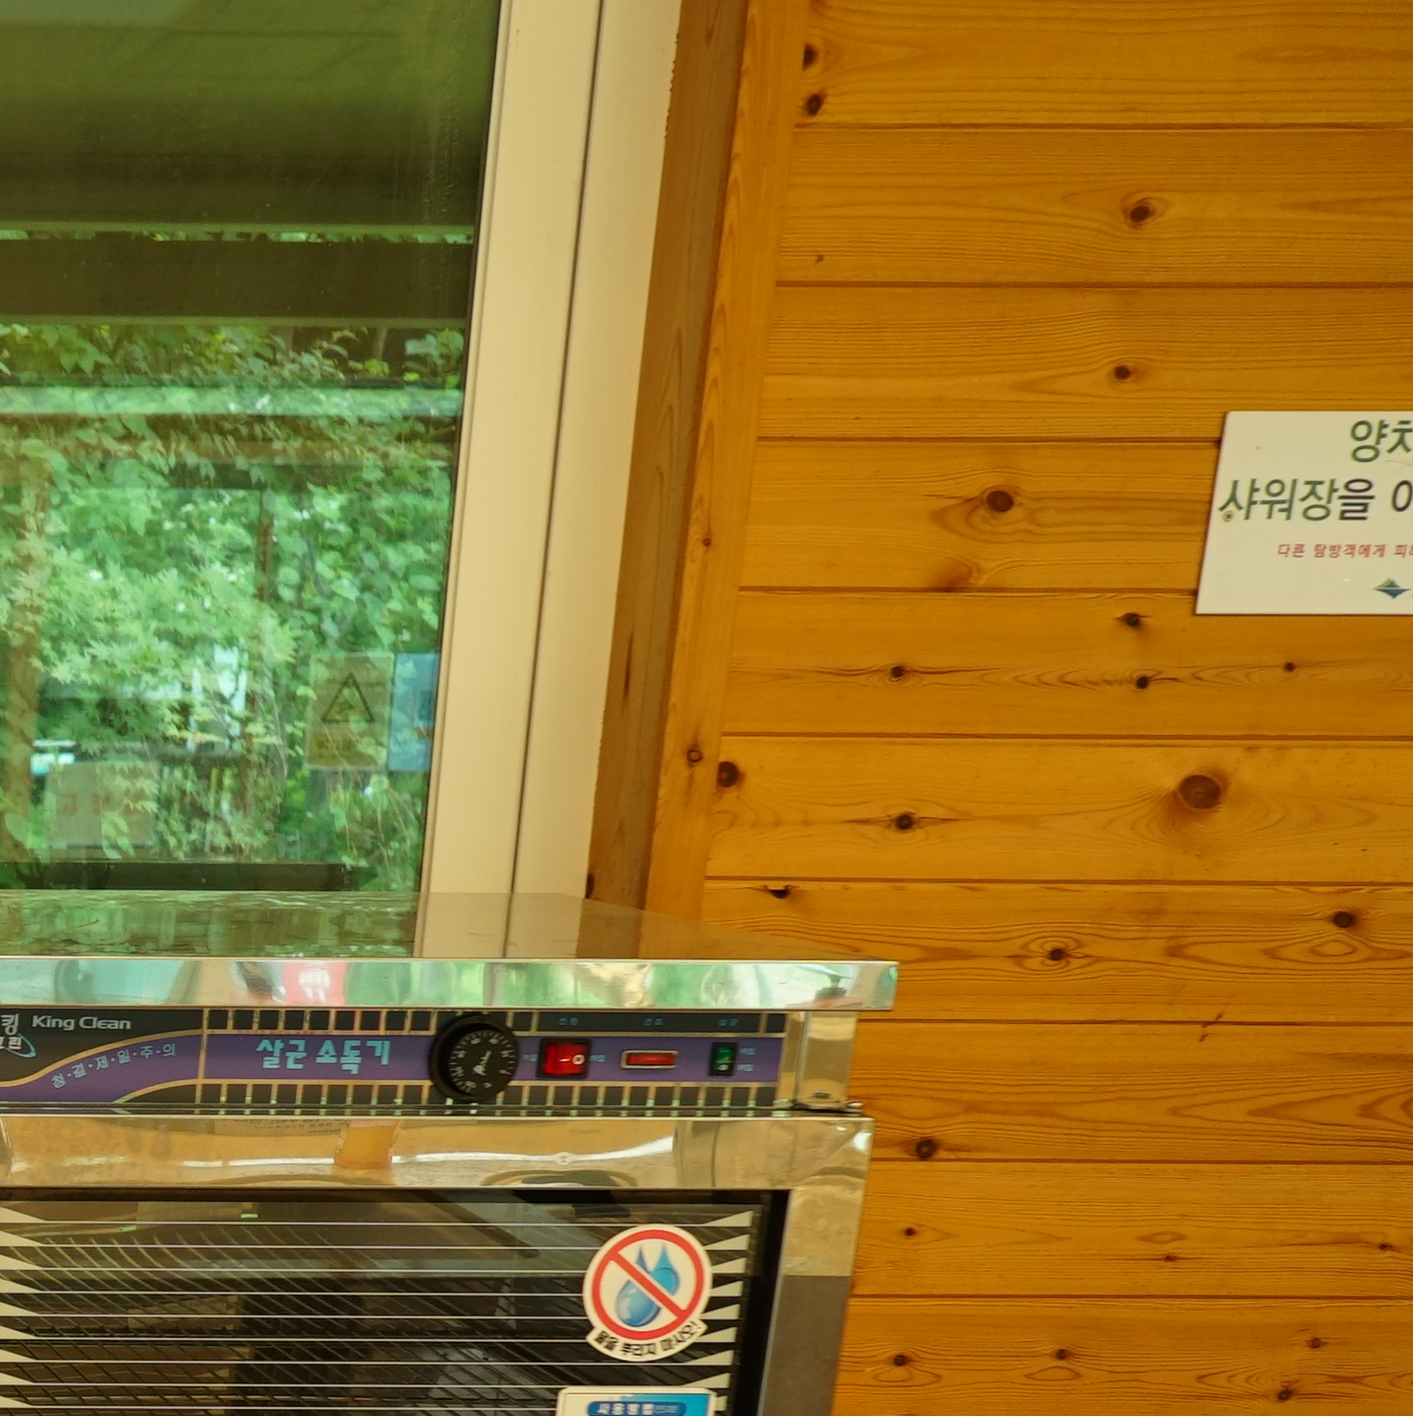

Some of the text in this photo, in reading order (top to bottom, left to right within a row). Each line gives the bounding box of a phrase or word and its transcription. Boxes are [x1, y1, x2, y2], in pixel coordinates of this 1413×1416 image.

[1218, 478, 1375, 521] 샤워장을
[1277, 543, 1306, 558] 다른
[1313, 543, 1387, 559] 탐방객에게
[0, 1013, 20, 1036] 킹
[32, 1015, 131, 1031] King Clean
[256, 1039, 391, 1075] 살균 소독기
